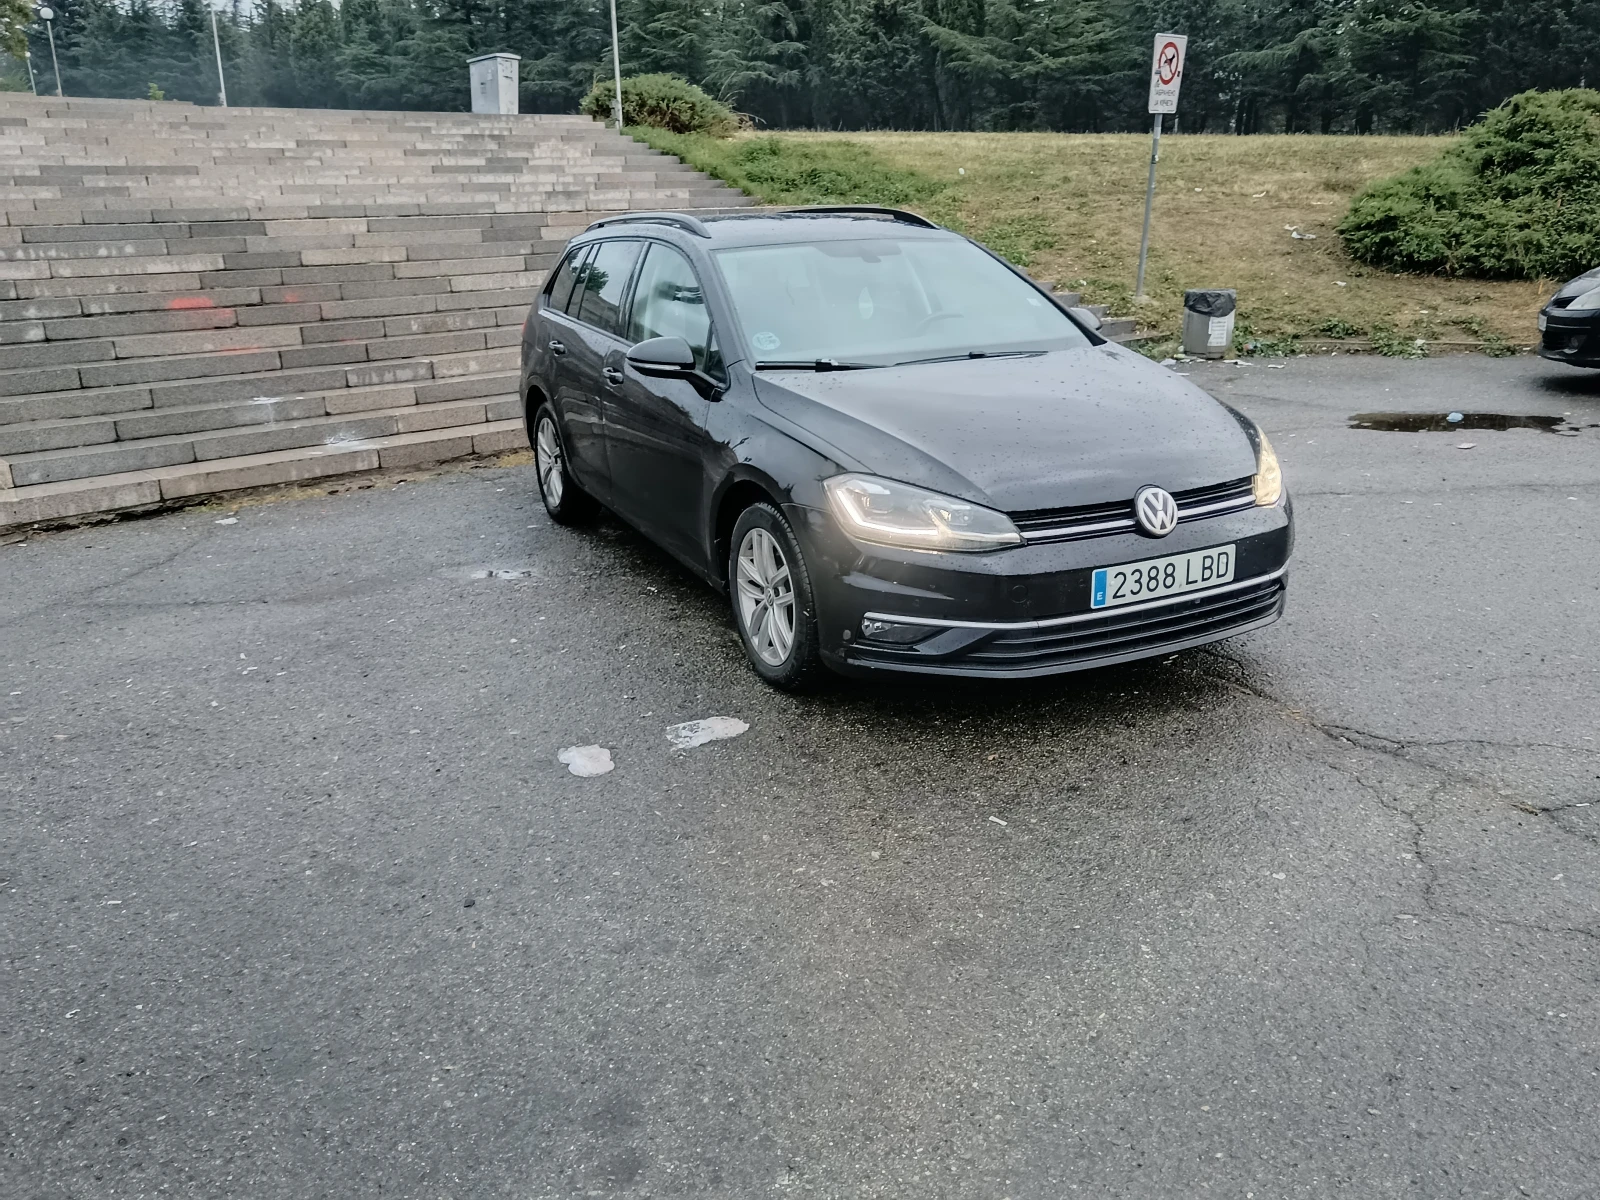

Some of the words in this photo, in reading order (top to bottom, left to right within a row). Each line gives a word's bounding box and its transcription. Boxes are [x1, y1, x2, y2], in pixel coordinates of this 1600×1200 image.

[1138, 488, 1177, 535] VW
[1096, 591, 1104, 601] E
[1112, 562, 1176, 600] 2388
[1185, 551, 1230, 586] LBD
